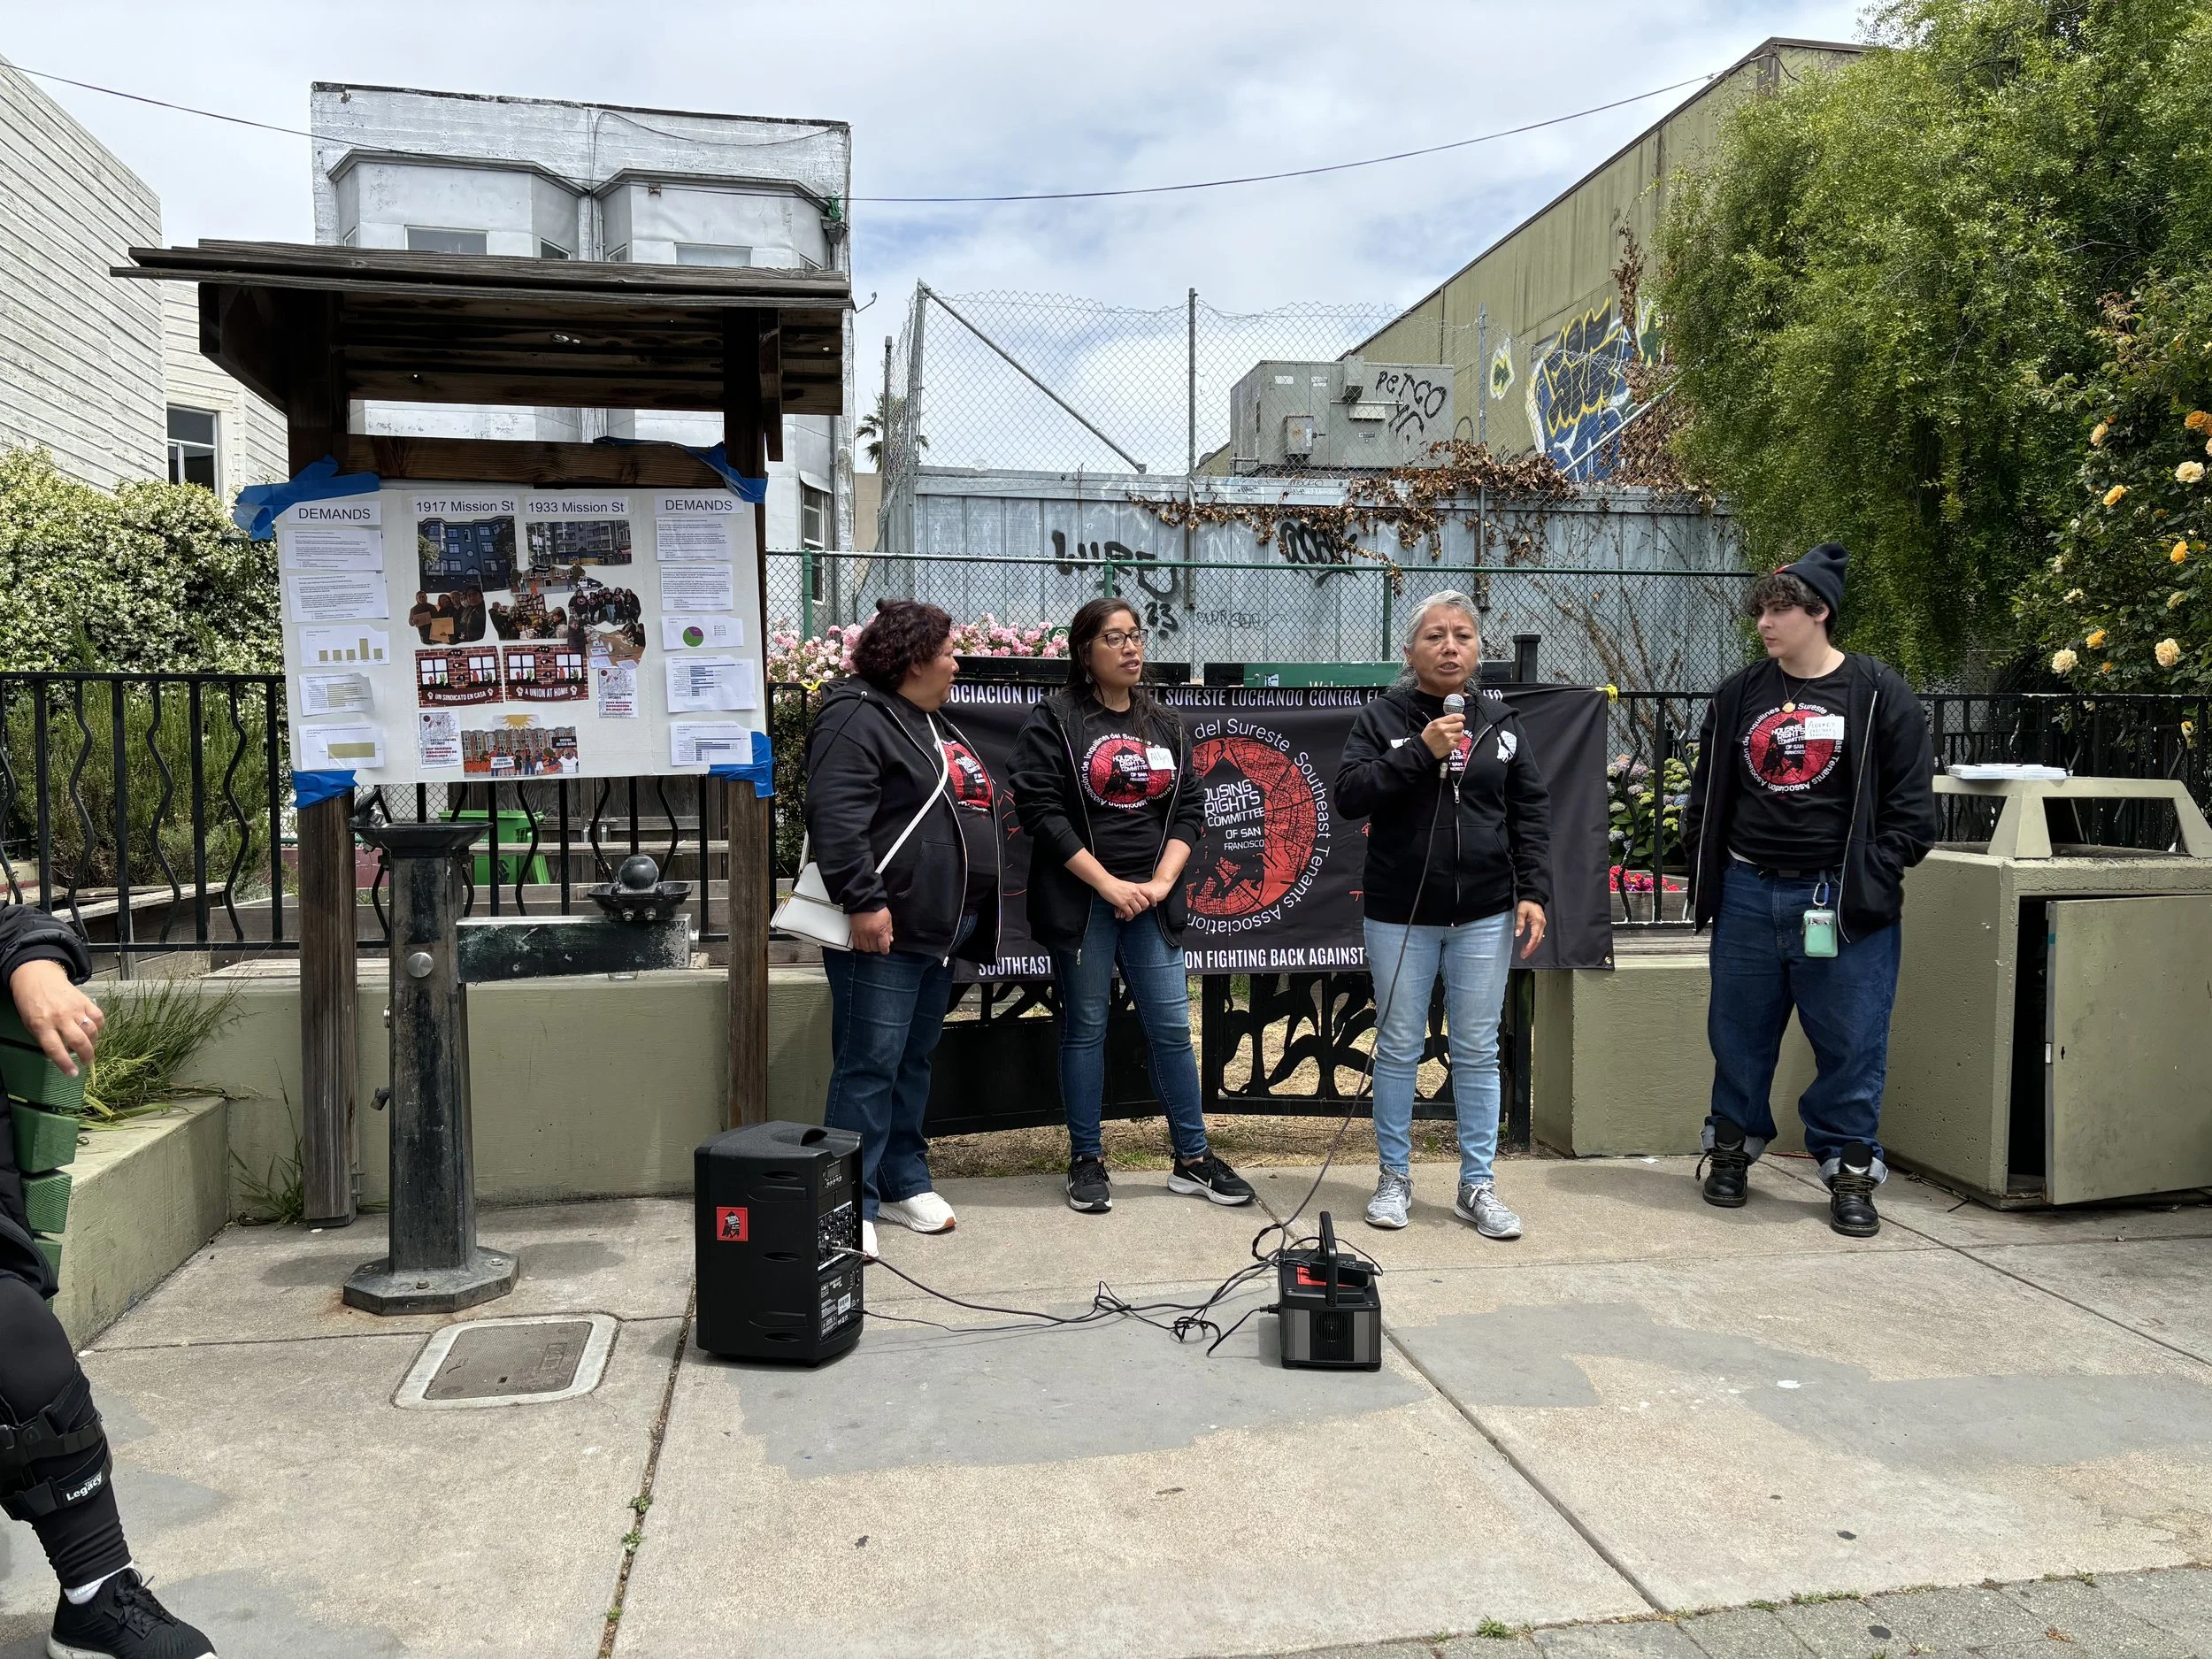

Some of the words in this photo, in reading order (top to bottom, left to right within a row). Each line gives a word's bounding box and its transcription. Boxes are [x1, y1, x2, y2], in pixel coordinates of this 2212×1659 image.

[298, 508, 371, 520] DEMANDS
[416, 501, 446, 513] 1917
[450, 501, 497, 512] Mission
[502, 500, 514, 511] St
[528, 502, 558, 513] 1933
[562, 502, 608, 513] Mission
[611, 502, 625, 512] St
[665, 499, 733, 511] DEMANDS
[554, 687, 569, 696] HOME
[946, 682, 1022, 704] OCIACIÓN
[1166, 688, 1226, 706] SURESTE
[1232, 689, 1303, 706] LUCHANDO
[1309, 689, 1363, 706] CONTRA
[1797, 703, 1828, 717] Sureste
[1194, 718, 1221, 740] del
[1227, 718, 1290, 752] Sureste
[1742, 735, 1750, 746] de
[1080, 761, 1090, 772] de
[1812, 756, 1840, 786] Tenants
[1204, 780, 1253, 803] USING
[1294, 751, 1332, 839] Southeast
[1204, 791, 1261, 818] RIGHTS
[1207, 808, 1265, 827] COMMITTEE
[1225, 829, 1239, 840] OF
[1240, 826, 1262, 838] SAN
[1224, 839, 1265, 851] FRANCISCO
[1285, 846, 1331, 908] Tenants
[1207, 949, 1266, 969] FIGHTING
[1271, 948, 1306, 966] BACK
[1310, 947, 1365, 965] AGAINST
[65, 1472, 102, 1502] Legacy
